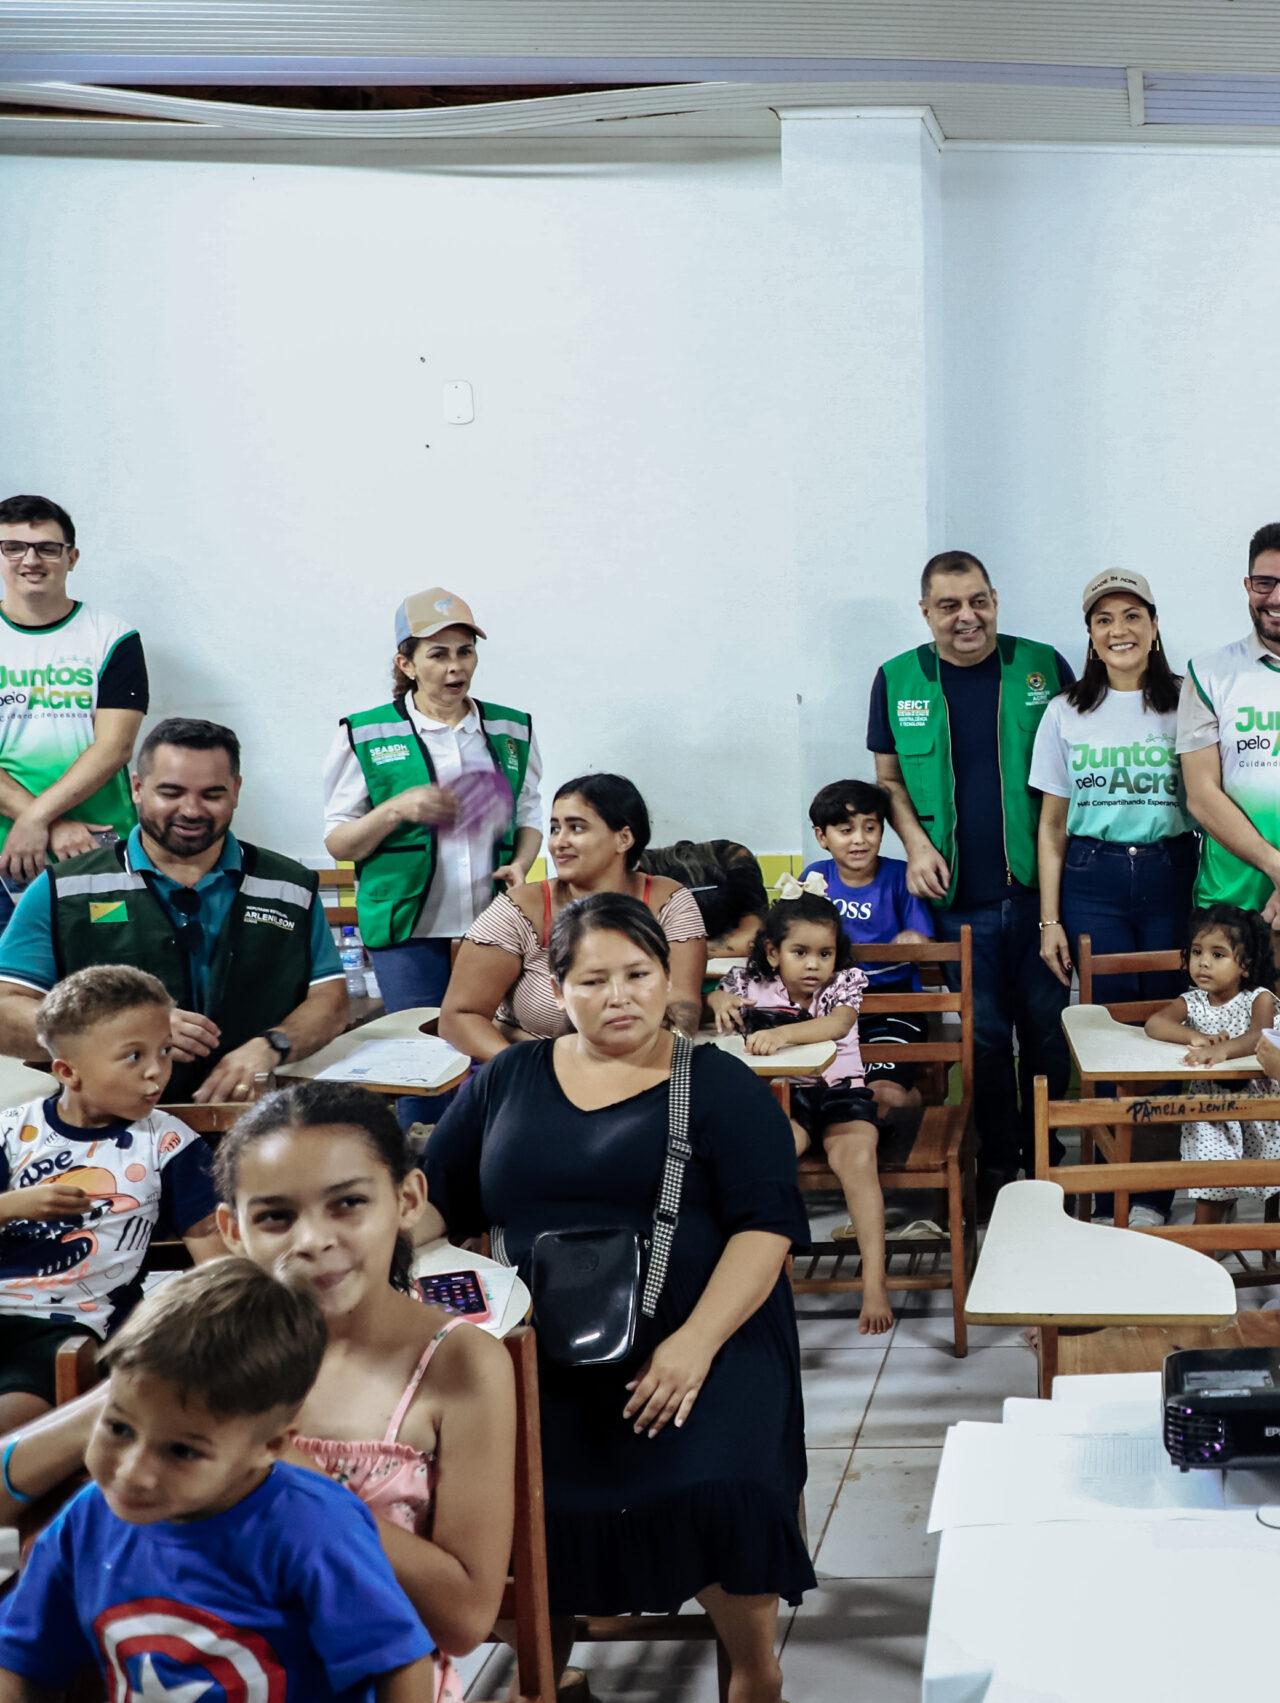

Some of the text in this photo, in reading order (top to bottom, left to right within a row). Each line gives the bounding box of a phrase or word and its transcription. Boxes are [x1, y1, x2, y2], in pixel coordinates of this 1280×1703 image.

[27, 686, 93, 710] Acre
[897, 699, 930, 710] SEICT
[1072, 741, 1181, 771] Juntos
[1236, 735, 1271, 754] pelo
[1108, 767, 1180, 796] Acre
[1092, 798, 1145, 808] Compartilhando
[828, 897, 872, 920] OSS
